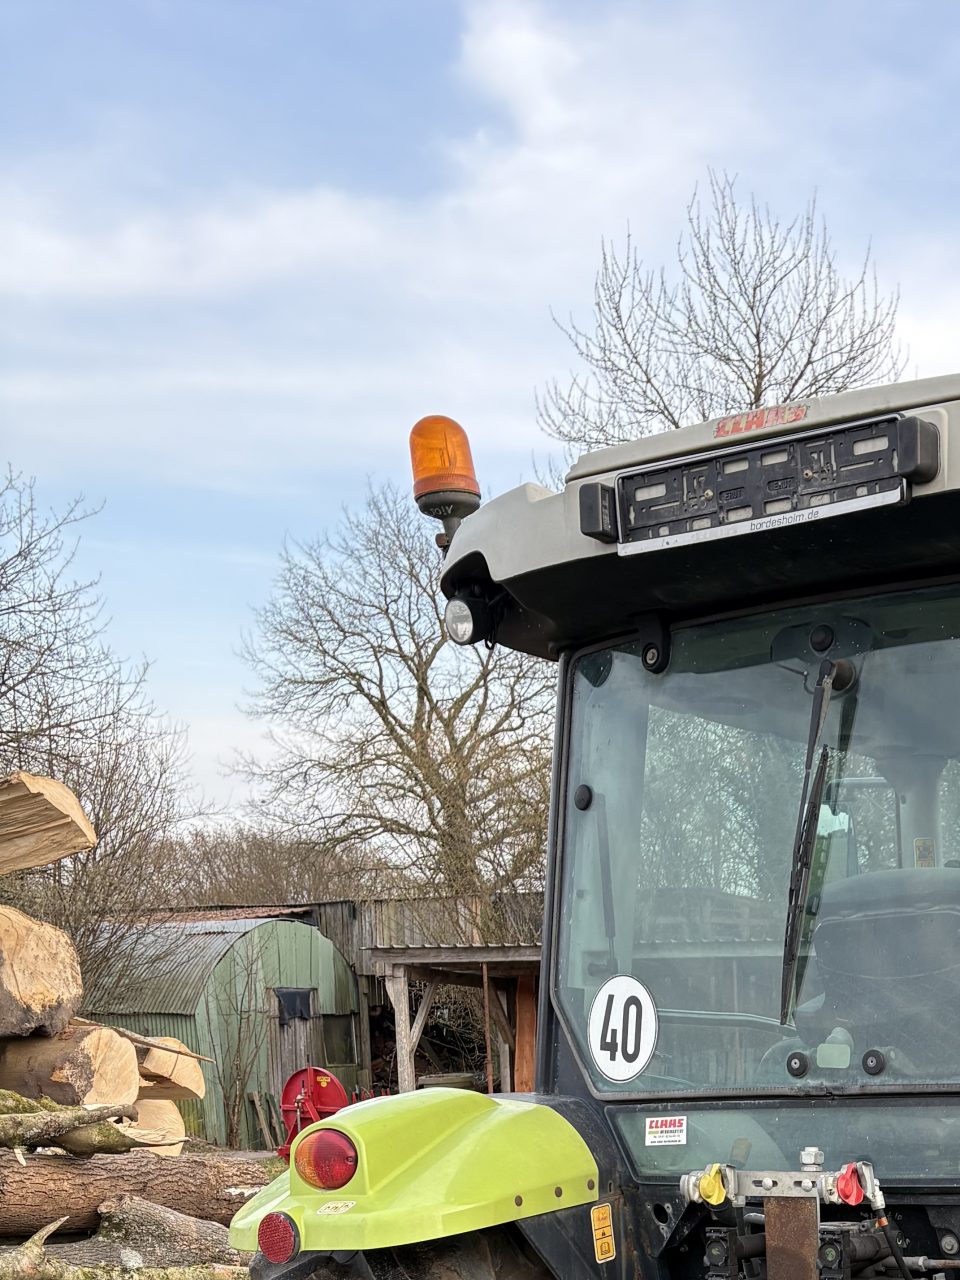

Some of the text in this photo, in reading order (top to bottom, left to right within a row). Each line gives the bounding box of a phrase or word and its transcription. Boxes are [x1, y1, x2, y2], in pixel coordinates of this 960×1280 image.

[750, 509, 819, 531] bordesholm.de
[600, 994, 642, 1064] 40
[648, 1118, 684, 1129] CLAAS
